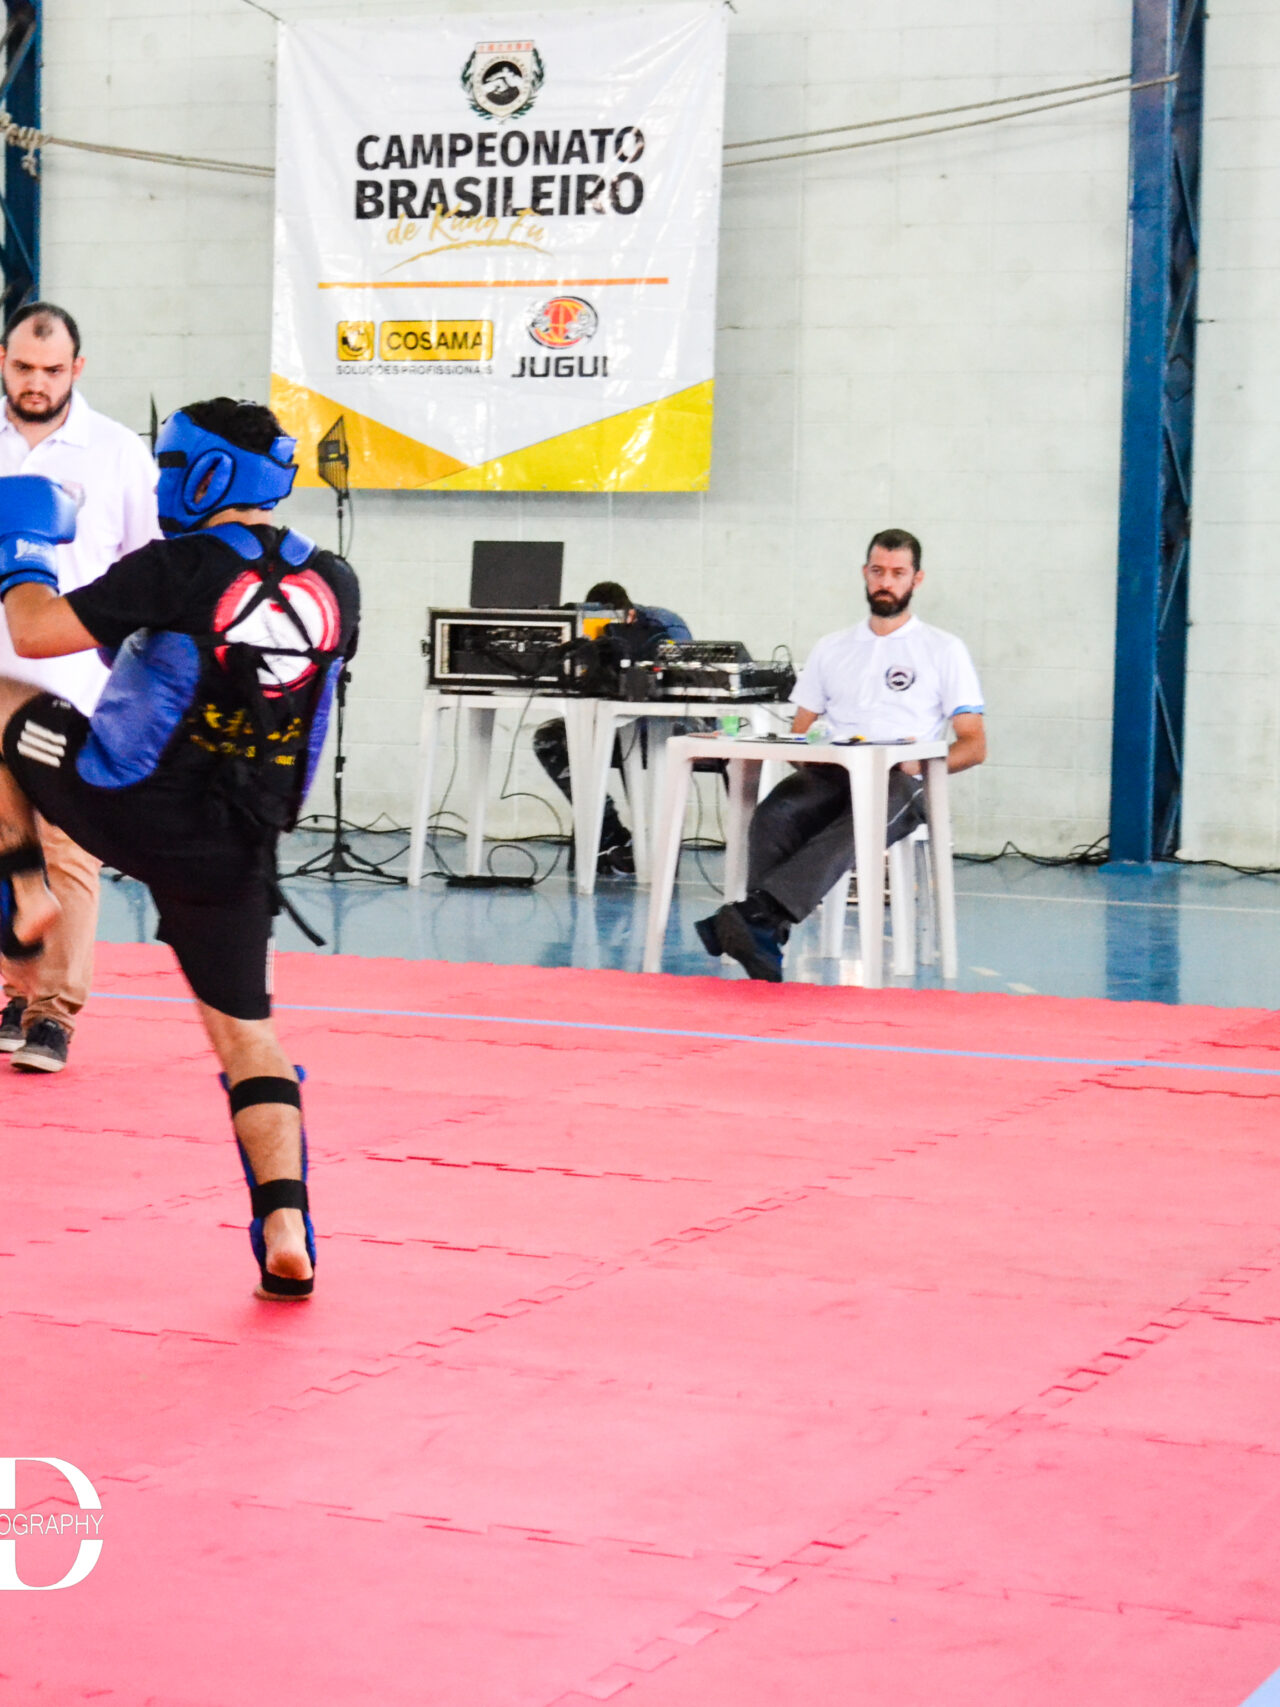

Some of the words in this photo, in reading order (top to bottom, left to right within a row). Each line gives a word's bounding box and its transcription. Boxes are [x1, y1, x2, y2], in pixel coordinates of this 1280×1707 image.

[356, 126, 645, 171] CAMPEONATO
[355, 172, 644, 220] BRASILEIRO
[387, 212, 419, 244] de
[429, 202, 499, 242] Kung
[507, 207, 544, 242] Fu
[387, 331, 483, 350] COSAMA
[511, 356, 608, 378] JUGUI
